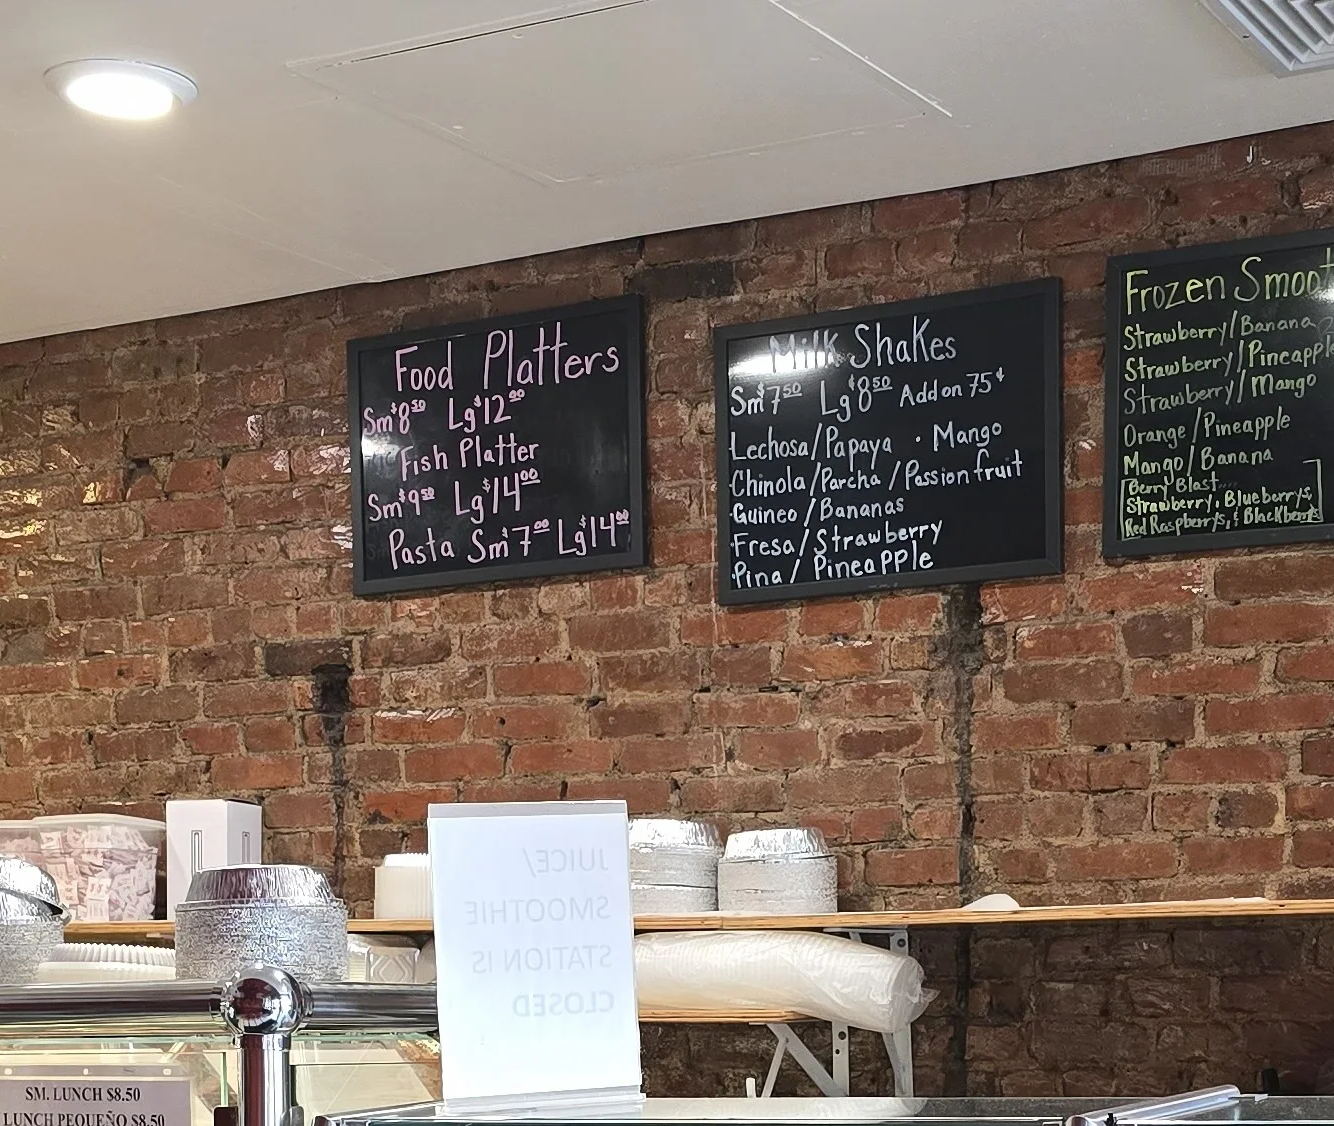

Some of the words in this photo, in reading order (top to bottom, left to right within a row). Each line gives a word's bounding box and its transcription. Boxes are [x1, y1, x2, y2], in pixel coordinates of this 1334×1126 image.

[1126, 270, 1226, 315] Frozen
[396, 341, 453, 391] Food
[483, 322, 619, 389] Platters
[400, 445, 448, 481] Fish
[459, 433, 539, 468] Platter
[933, 421, 1002, 451] Mango
[389, 527, 454, 570] Pasta
[25, 1086, 50, 1101] SM.
[53, 1087, 103, 1102] LUNCH
[106, 1087, 141, 1102] $8.50
[3, 1112, 54, 1126] LUNCH
